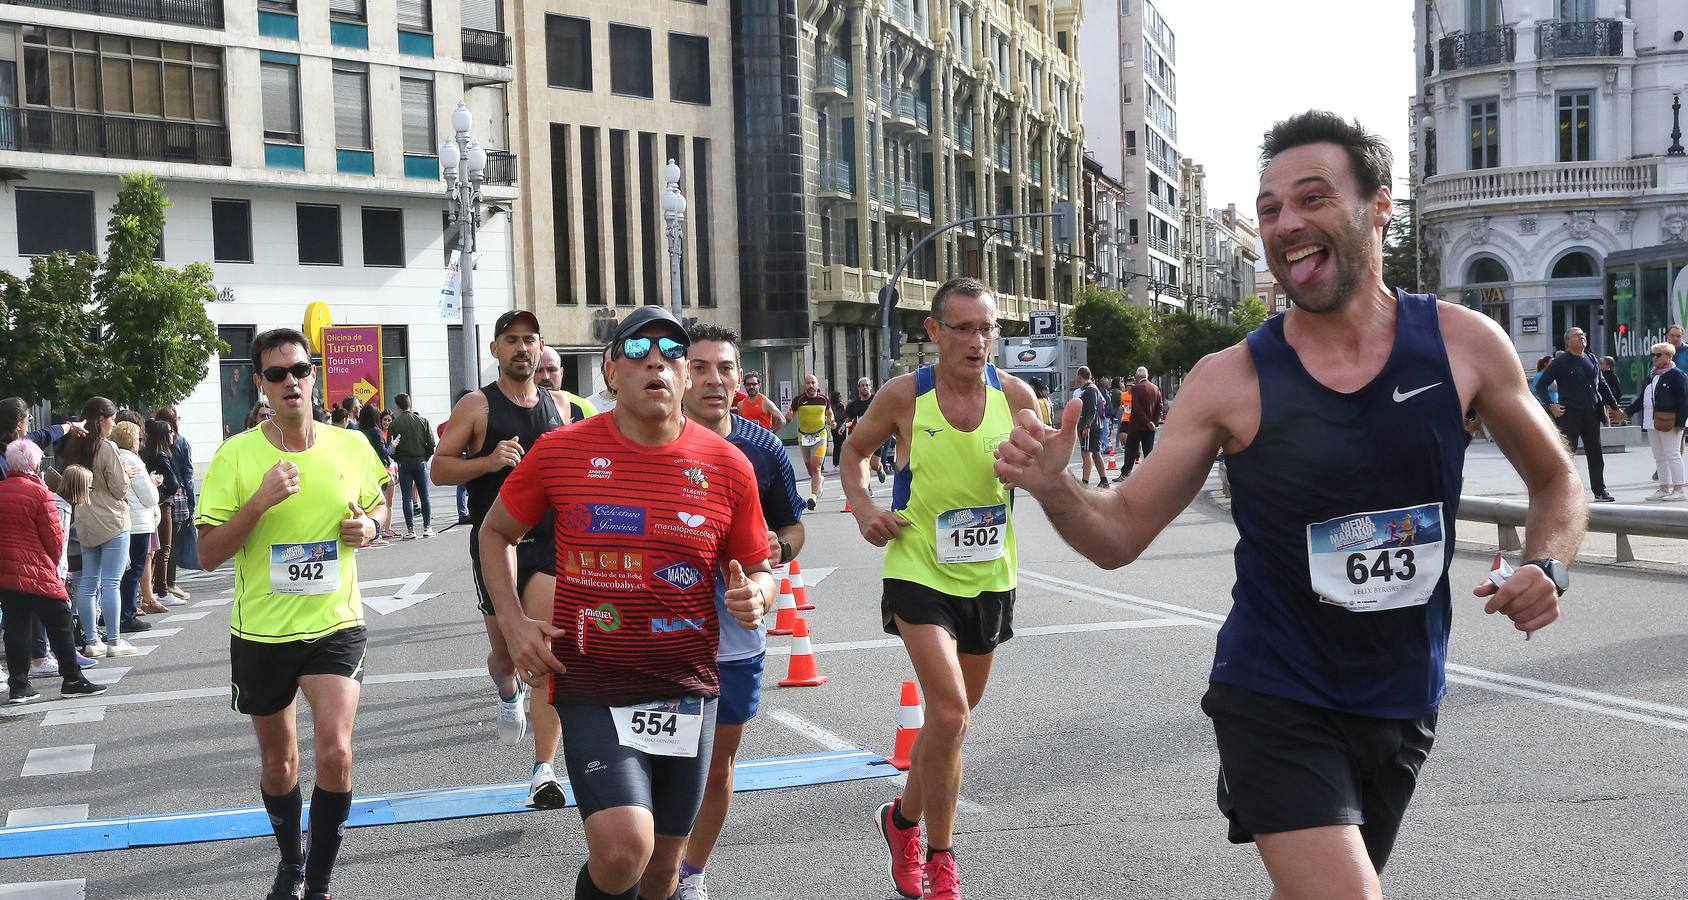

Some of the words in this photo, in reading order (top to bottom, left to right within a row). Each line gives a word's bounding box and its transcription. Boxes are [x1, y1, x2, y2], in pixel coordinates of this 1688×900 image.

[1480, 287, 1505, 304] VA
[1034, 316, 1052, 335] P
[326, 334, 352, 342] Oficina
[353, 333, 363, 341] de
[1613, 328, 1668, 357] Valladoli
[327, 342, 374, 354] Turismo
[327, 356, 364, 366] Tourism
[327, 366, 349, 374] Office
[682, 487, 708, 496] ALBERTO
[594, 503, 641, 518] Celestino
[1340, 515, 1372, 533] MEDIA
[950, 527, 999, 548] 1502
[288, 562, 324, 582] 942
[588, 569, 608, 578] Mundo
[608, 571, 617, 579] de
[1346, 548, 1417, 585] 643
[565, 575, 646, 593] www.littlecocobaby.es
[631, 710, 678, 737] 554
